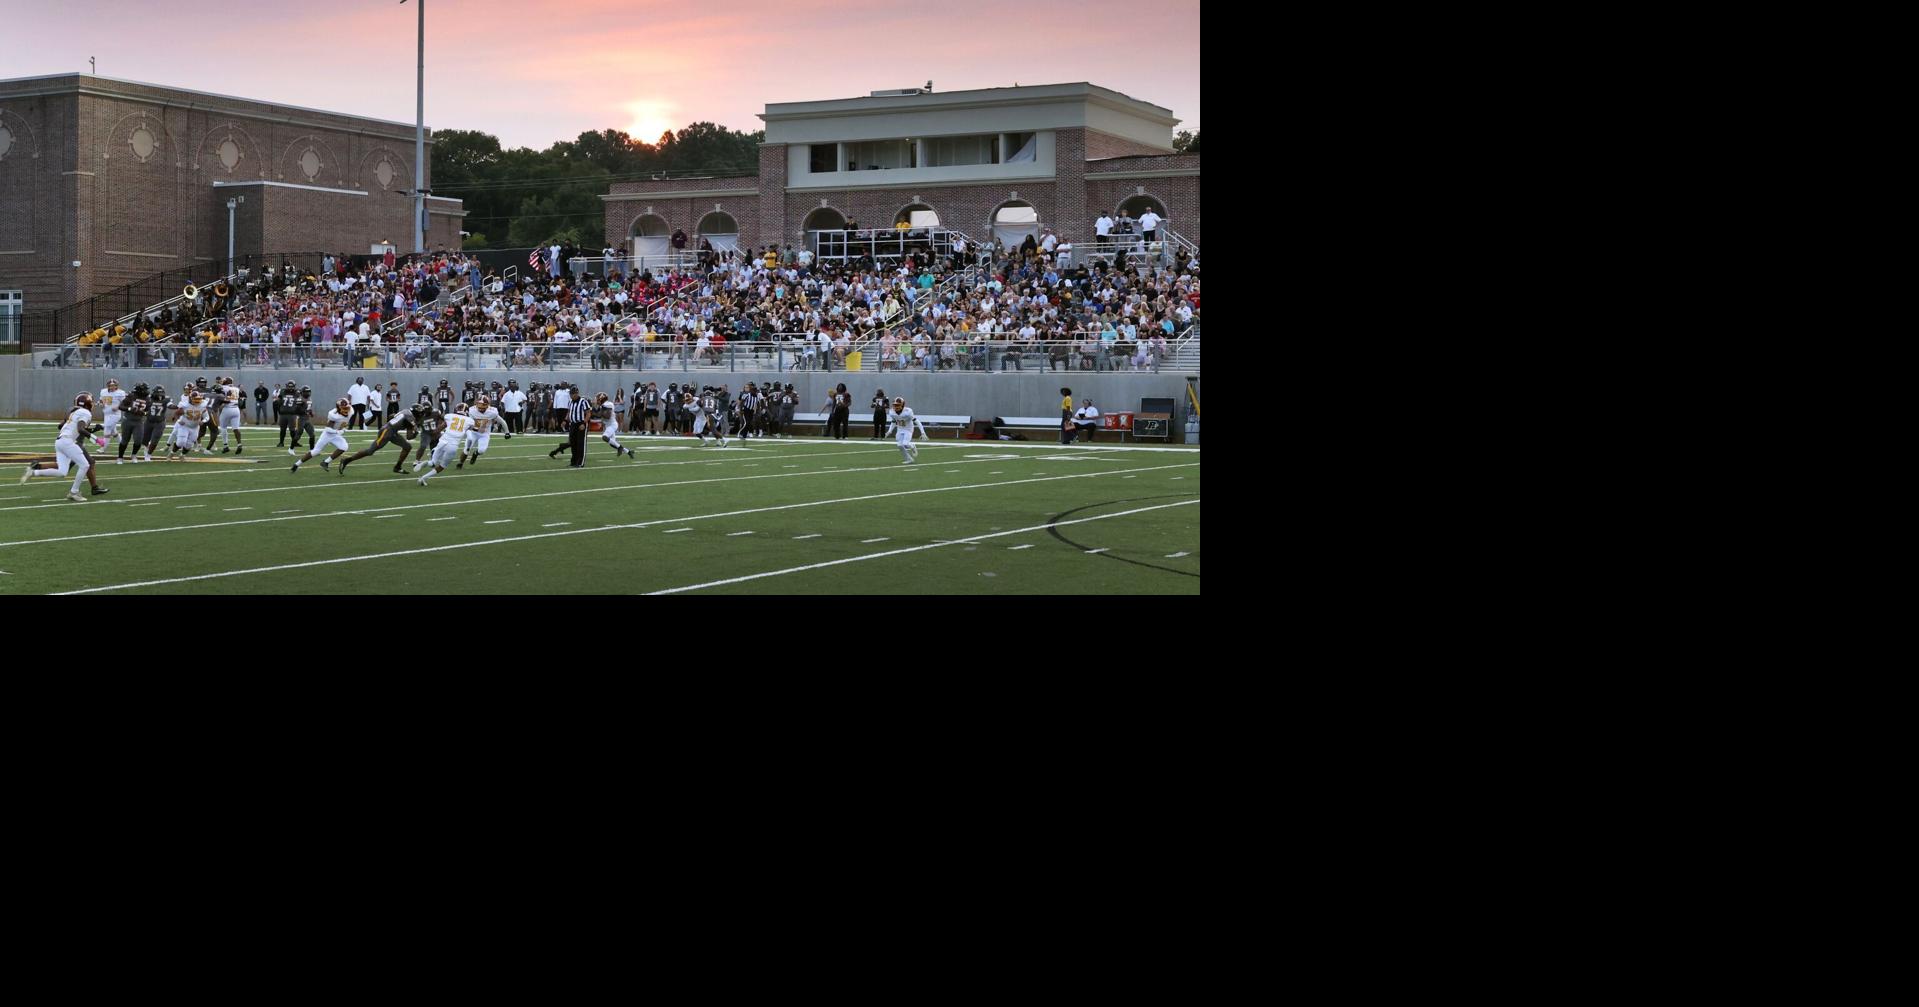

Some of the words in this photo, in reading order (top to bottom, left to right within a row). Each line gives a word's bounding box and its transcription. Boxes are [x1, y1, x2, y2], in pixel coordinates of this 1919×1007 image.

[283, 398, 294, 407] 75
[704, 398, 714, 409] 13
[150, 405, 163, 416] 67
[449, 417, 465, 433] 21
